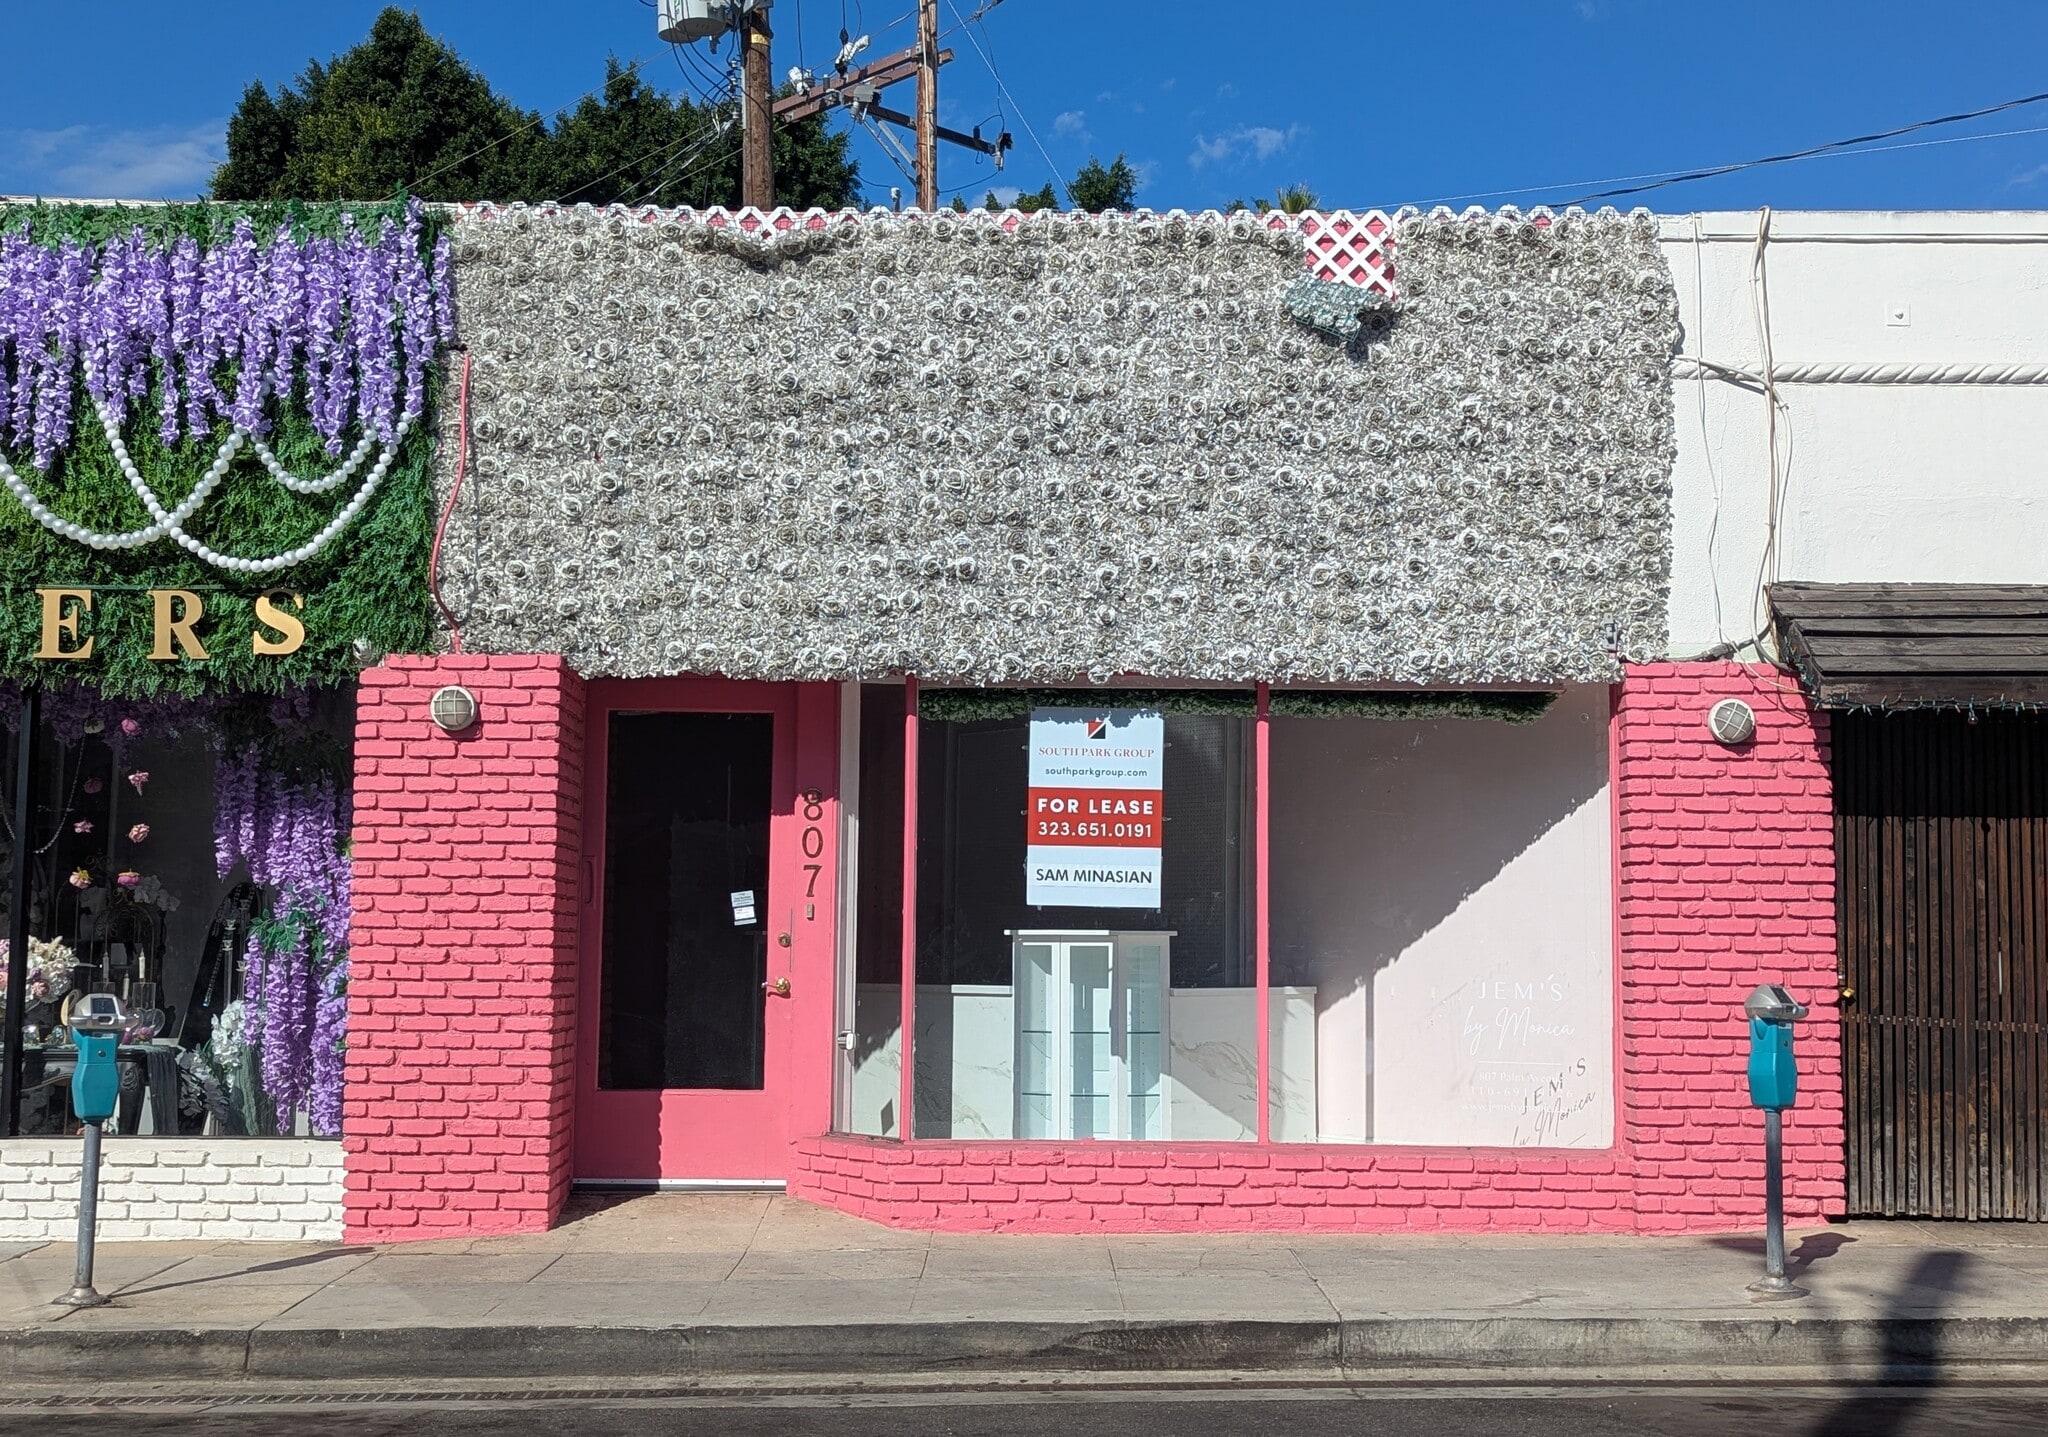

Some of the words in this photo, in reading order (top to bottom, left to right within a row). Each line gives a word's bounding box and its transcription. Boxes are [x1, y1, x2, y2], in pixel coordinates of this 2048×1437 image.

[1038, 746, 1079, 756] SOUTH
[1081, 747, 1111, 757] PARK
[1114, 748, 1155, 758] GROUP
[1045, 766, 1148, 778] southparkgroup.com
[1037, 798, 1080, 813] FOR
[1089, 799, 1154, 815] LEASE
[1038, 821, 1152, 837] 323.651.0191
[801, 787, 824, 898] 807
[1036, 868, 1069, 882] SAM
[1073, 869, 1152, 884] MINASIAN
[1478, 981, 1563, 1002] JEM'S
[1463, 1005, 1488, 1056] by
[1495, 1006, 1576, 1050] Monica
